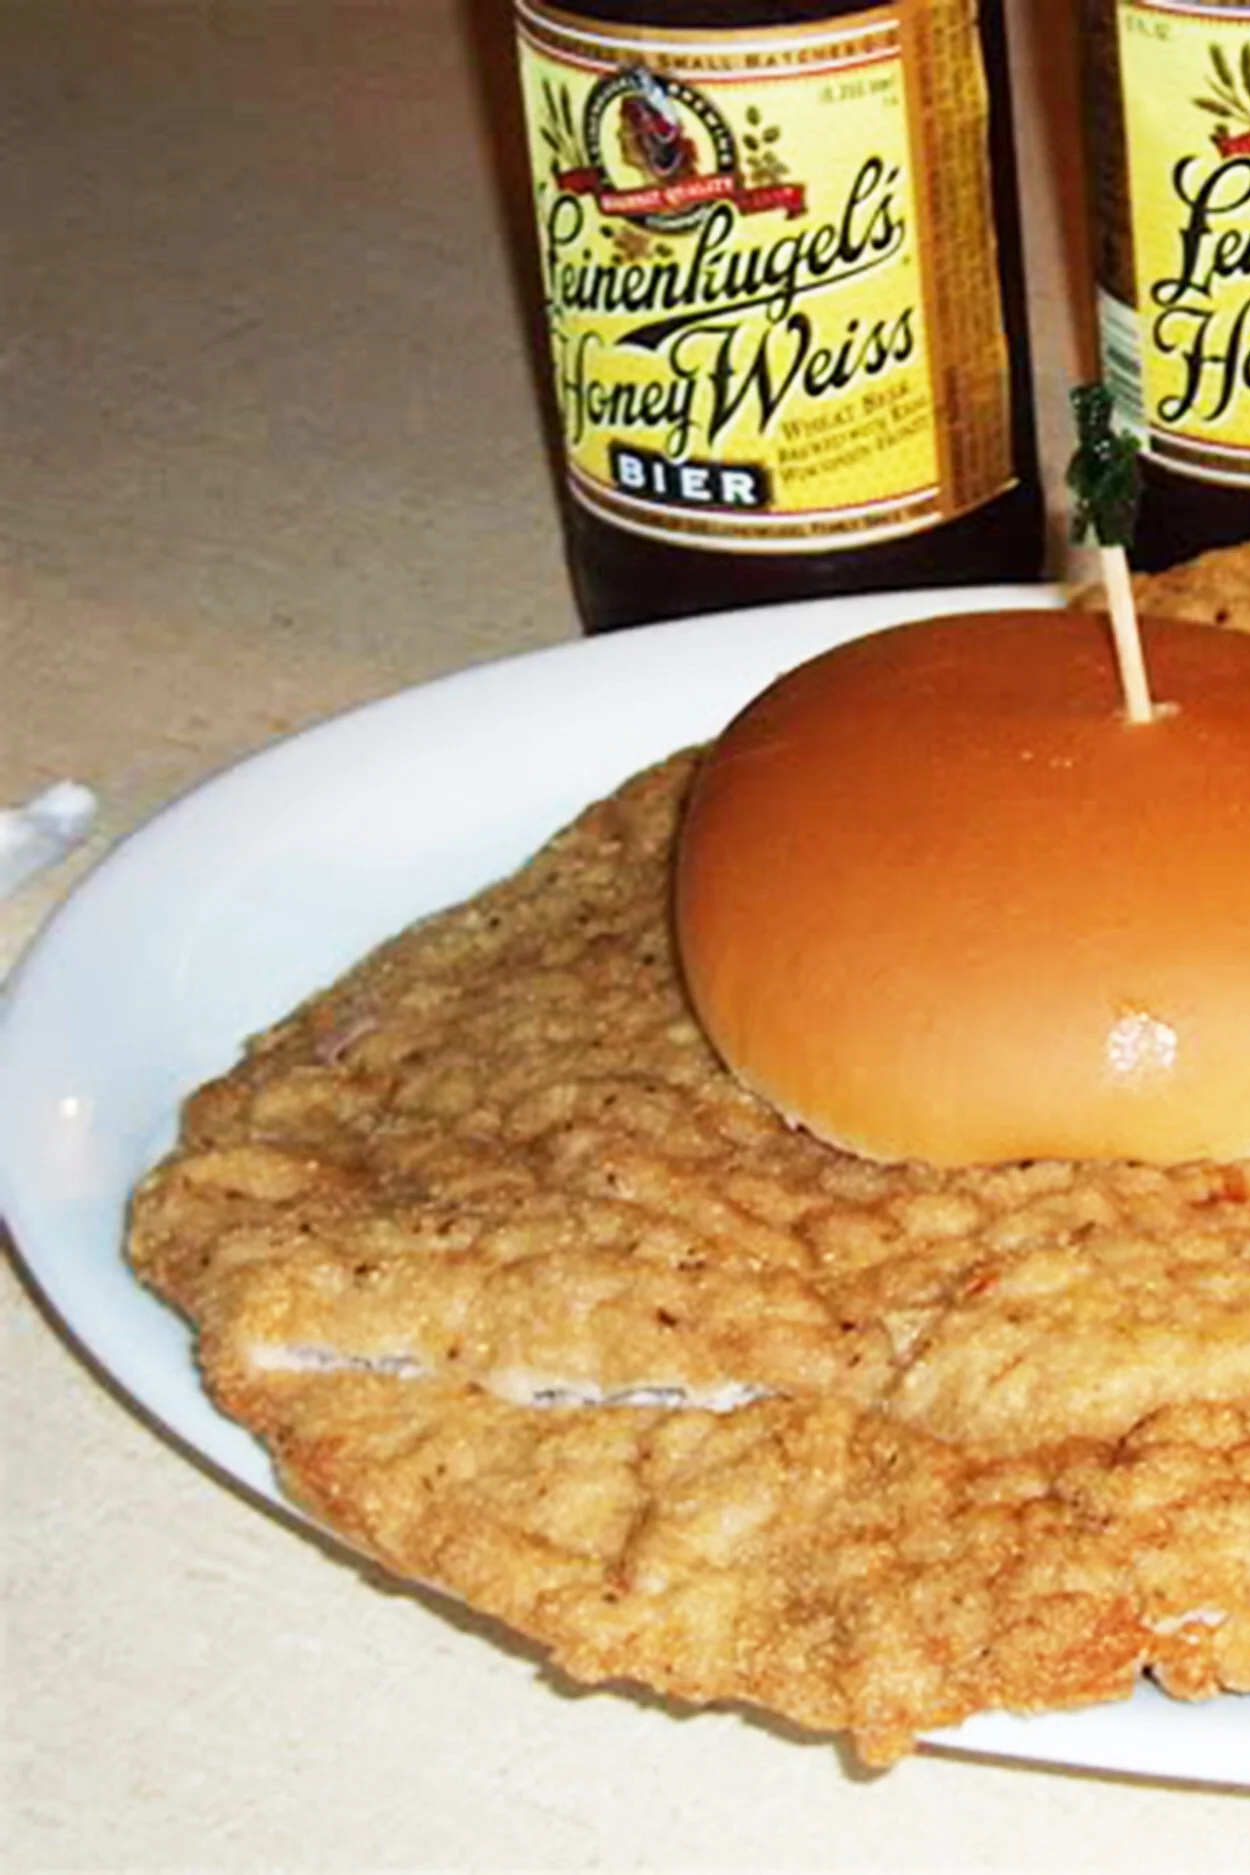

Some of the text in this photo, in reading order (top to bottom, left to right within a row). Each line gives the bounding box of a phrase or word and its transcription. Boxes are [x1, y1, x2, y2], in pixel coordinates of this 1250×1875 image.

[655, 52, 733, 72] SMALL
[668, 307, 913, 446] Weiss
[617, 452, 758, 505] BIER
